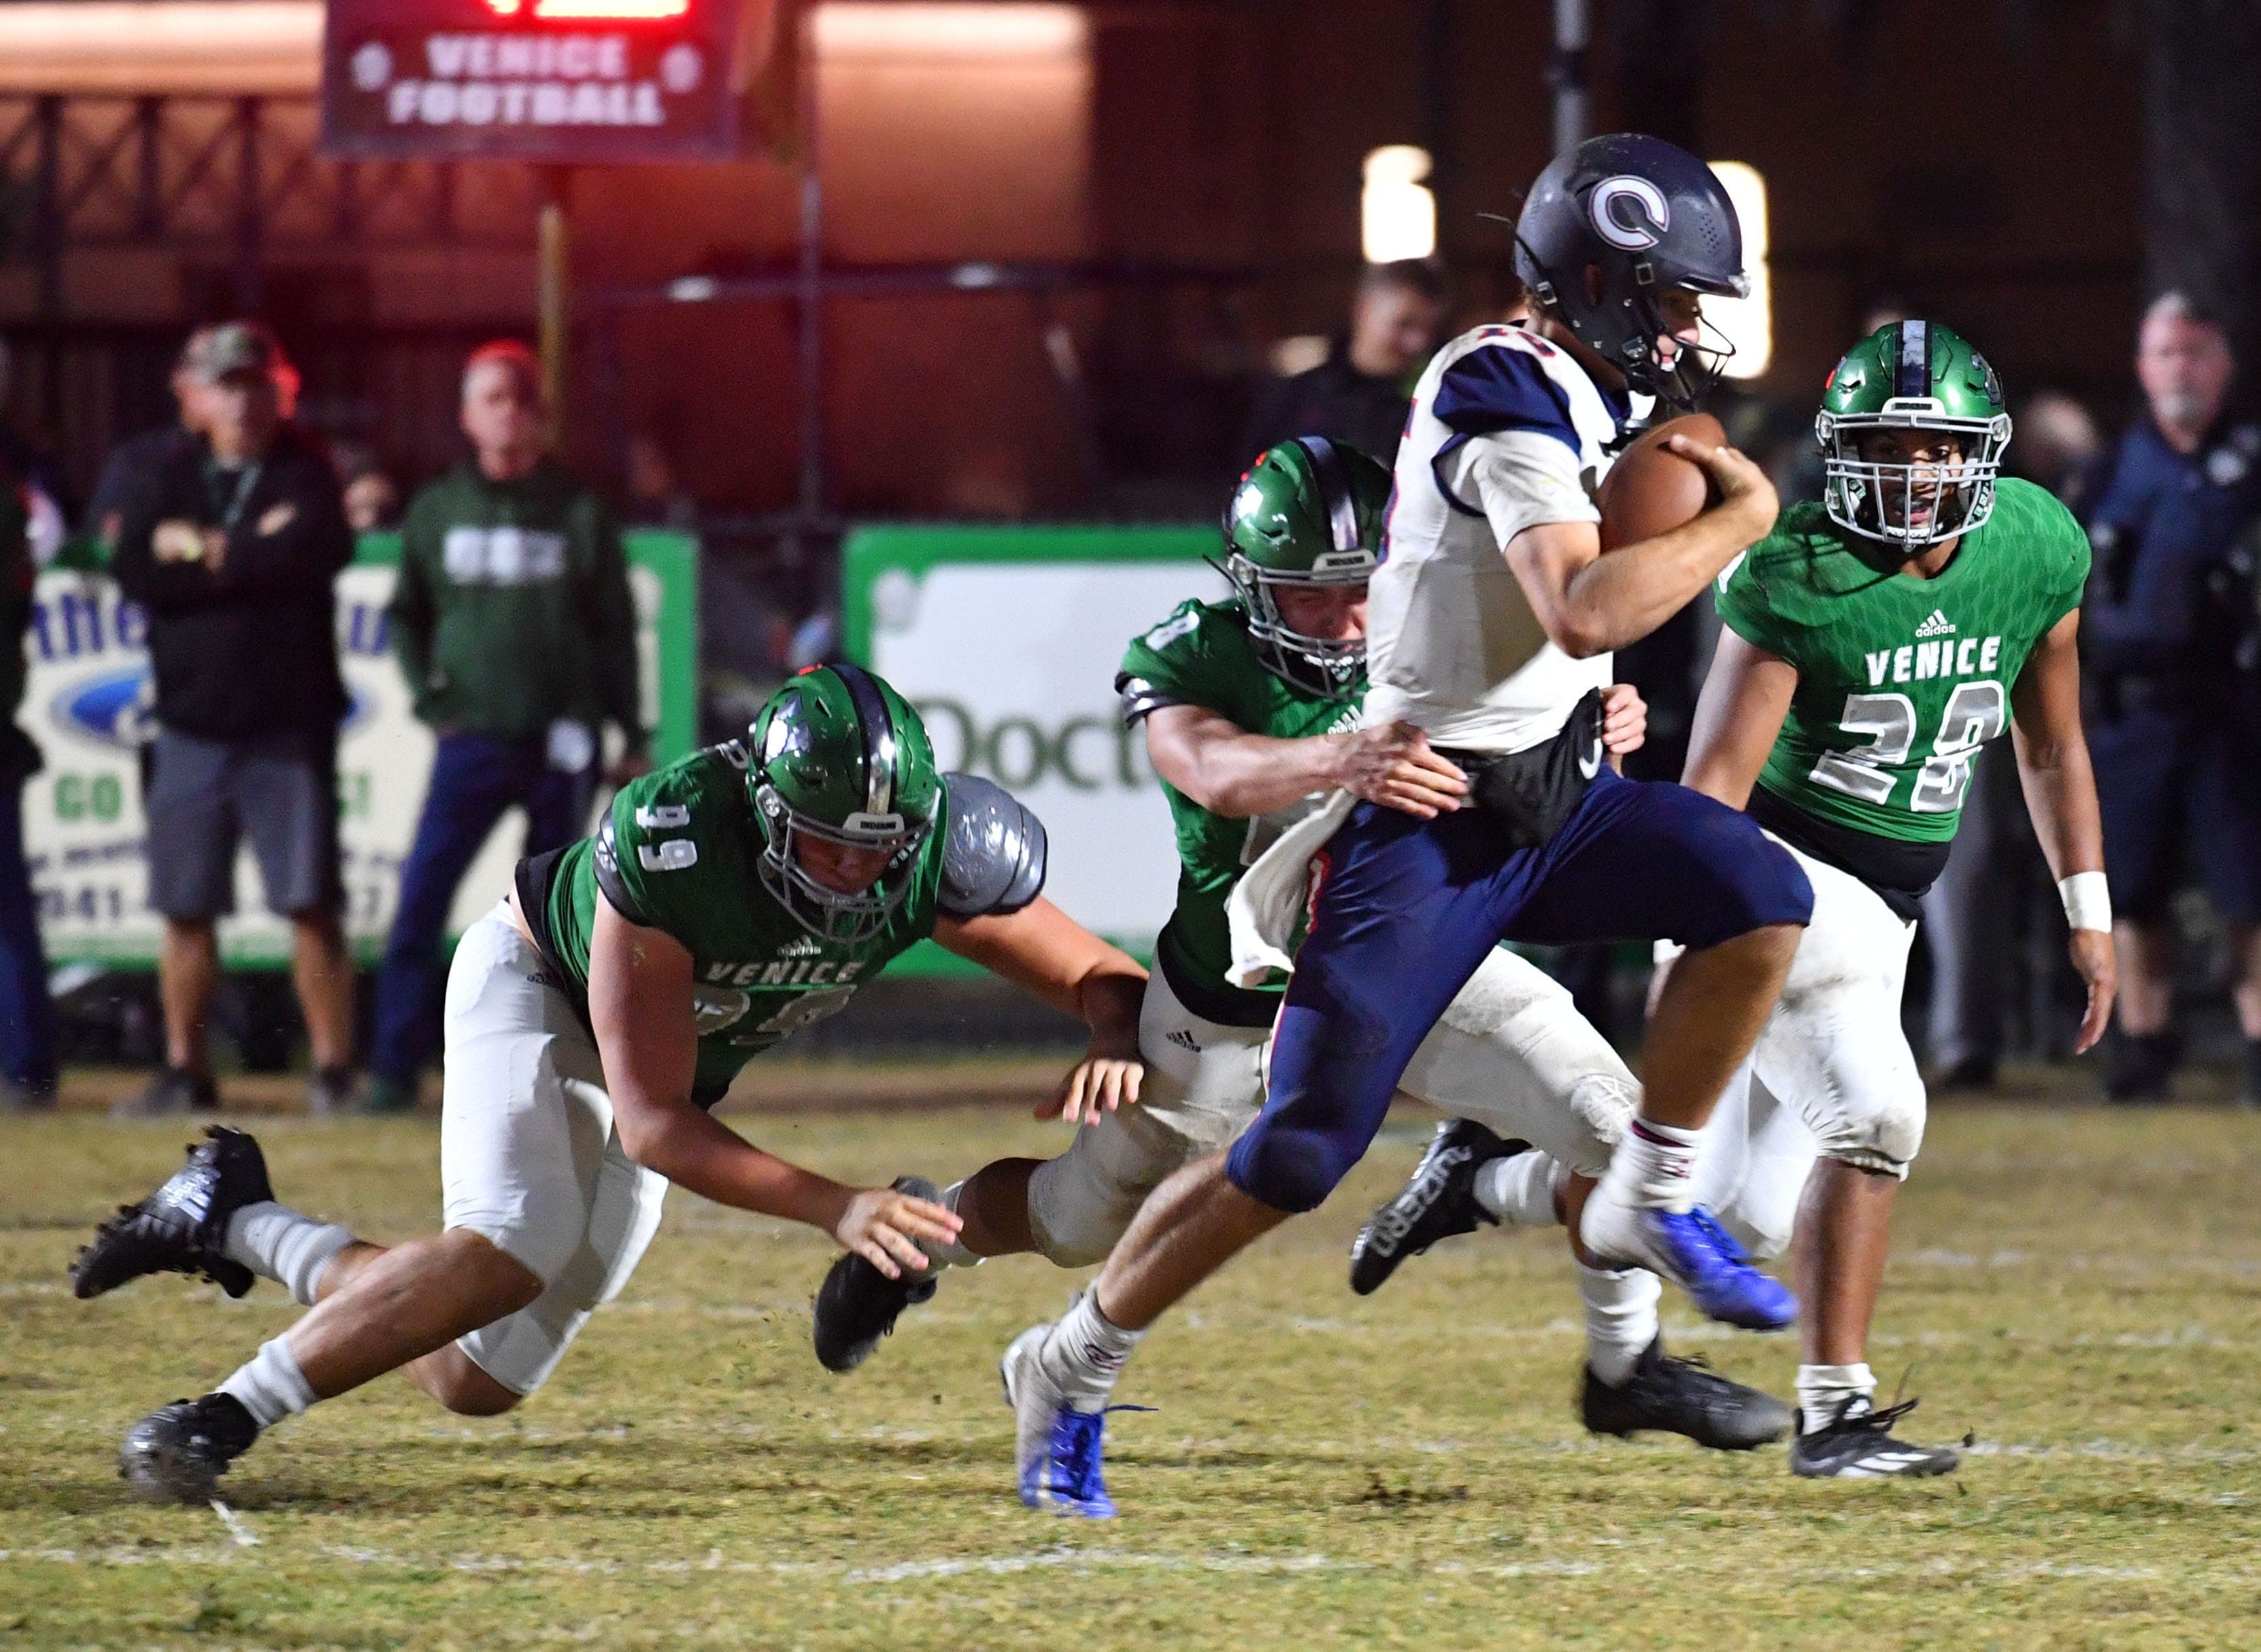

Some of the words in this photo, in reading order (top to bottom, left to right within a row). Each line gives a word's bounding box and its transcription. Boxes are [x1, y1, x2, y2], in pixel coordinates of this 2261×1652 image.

[426, 33, 629, 78] VENICE
[388, 79, 667, 124] FOOTBALL
[1589, 175, 1670, 251] C
[1915, 624, 1956, 638] adidas
[1864, 636, 2002, 686] VENICE
[707, 961, 865, 985] VENICE
